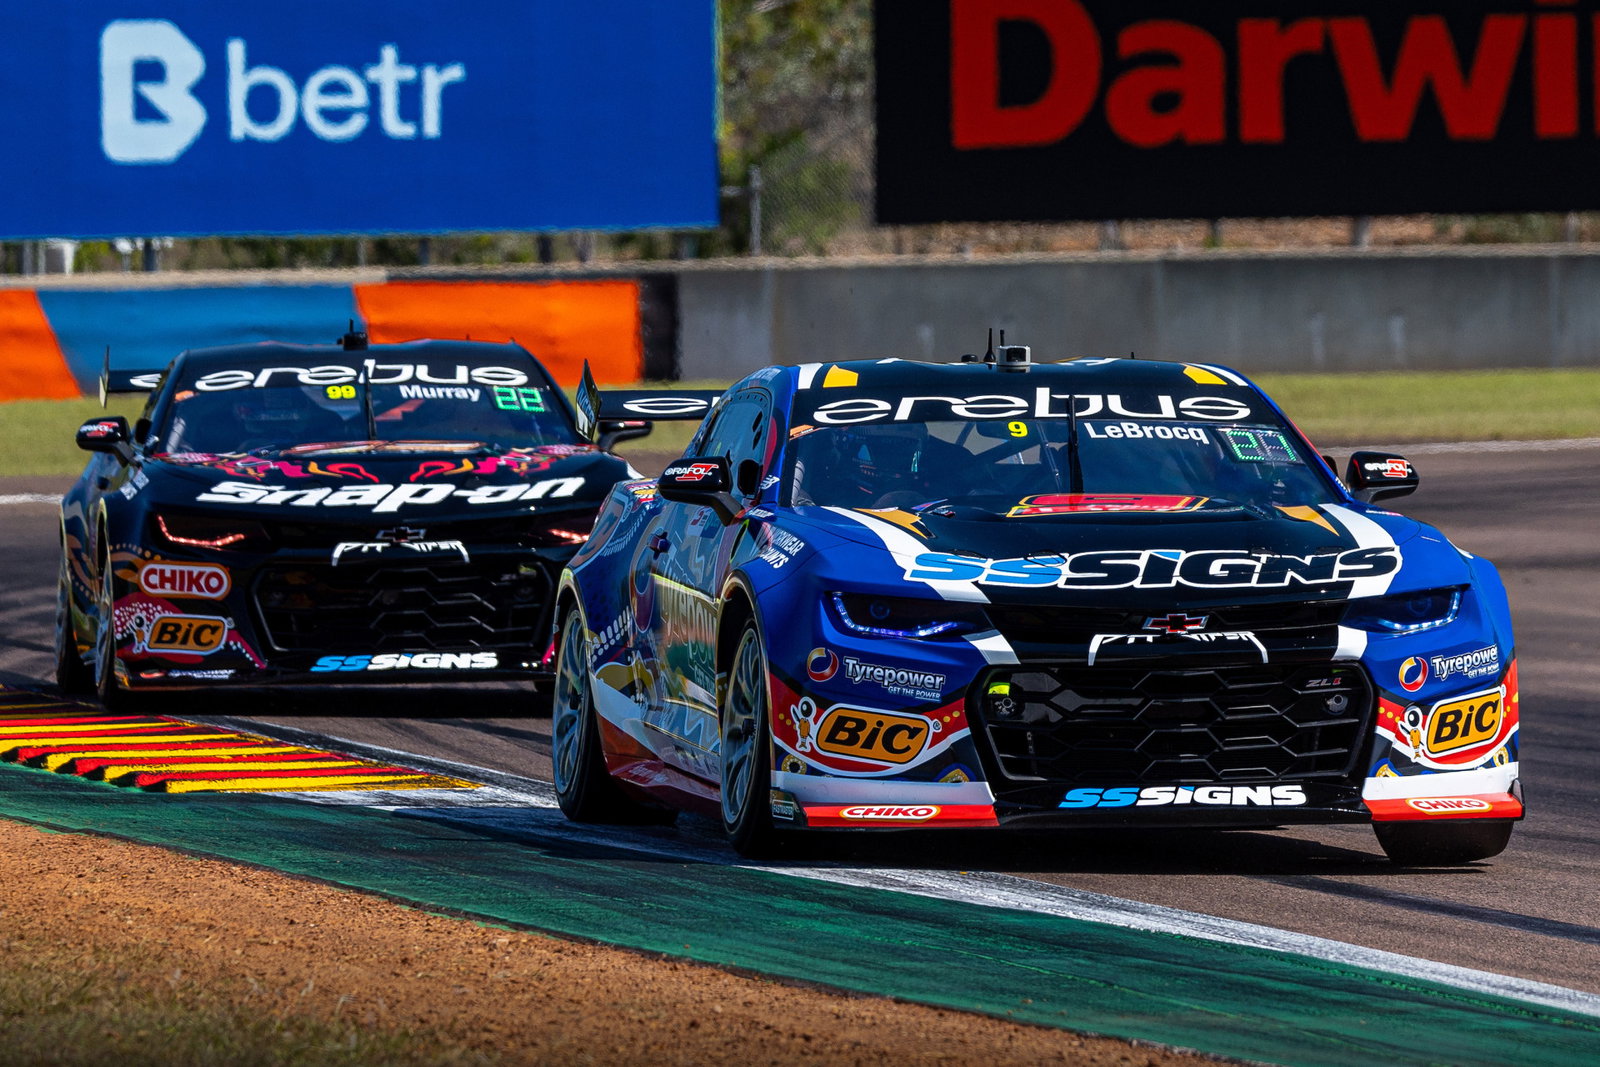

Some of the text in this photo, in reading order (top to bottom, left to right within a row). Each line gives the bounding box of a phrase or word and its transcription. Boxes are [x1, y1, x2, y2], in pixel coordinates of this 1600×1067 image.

[951, 0, 1600, 149] Darwi
[226, 38, 466, 141] betr
[326, 385, 356, 399] 99
[400, 385, 480, 402] Murray
[1008, 421, 1028, 437] 9
[1084, 422, 1210, 444] LeBrocq
[665, 467, 712, 476] ORAFOL
[143, 567, 225, 594] CHIKO
[844, 657, 945, 690] Tyrepower
[888, 686, 941, 699] GET THE POWER
[847, 805, 935, 817] CHIKO
[1412, 799, 1487, 811] CHIKO
